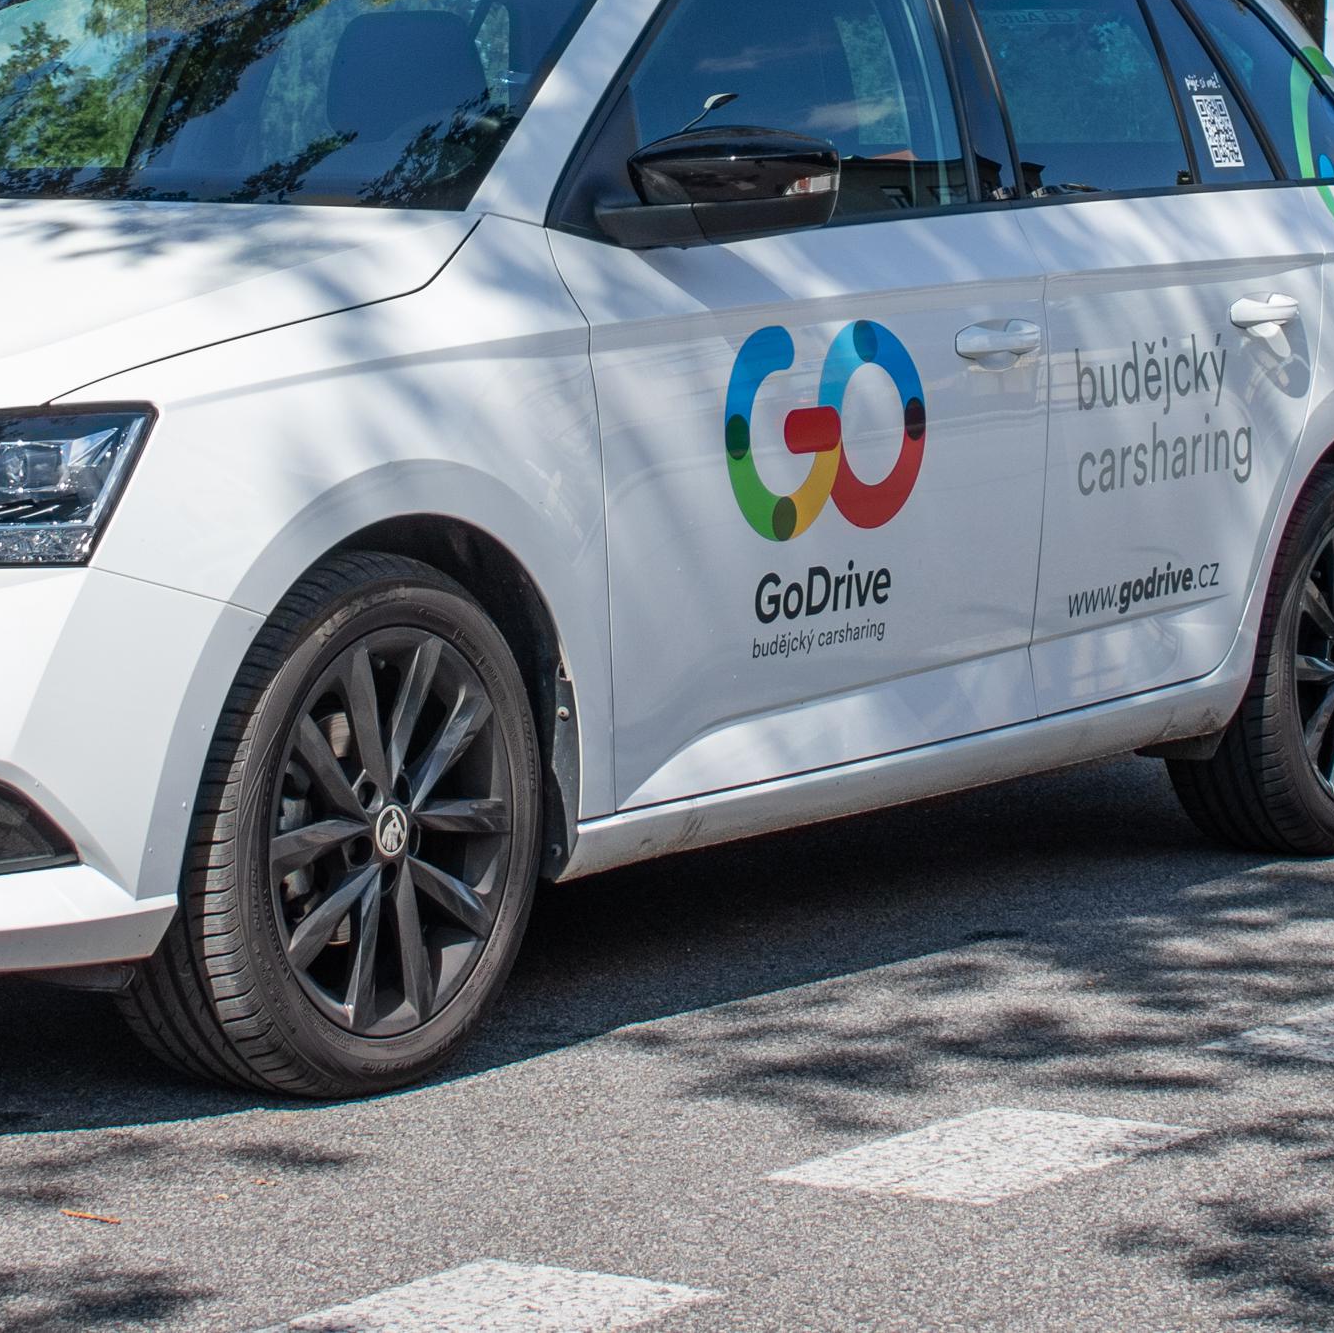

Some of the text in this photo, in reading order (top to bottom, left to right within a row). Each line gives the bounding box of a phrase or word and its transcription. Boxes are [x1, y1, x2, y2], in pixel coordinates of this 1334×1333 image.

[1075, 333, 1226, 415] budějcký
[1078, 413, 1252, 496] carsharing
[755, 560, 891, 624] GoDrive
[1068, 562, 1220, 618] www.godrive.cz
[752, 619, 886, 658] budějcký carsharing
